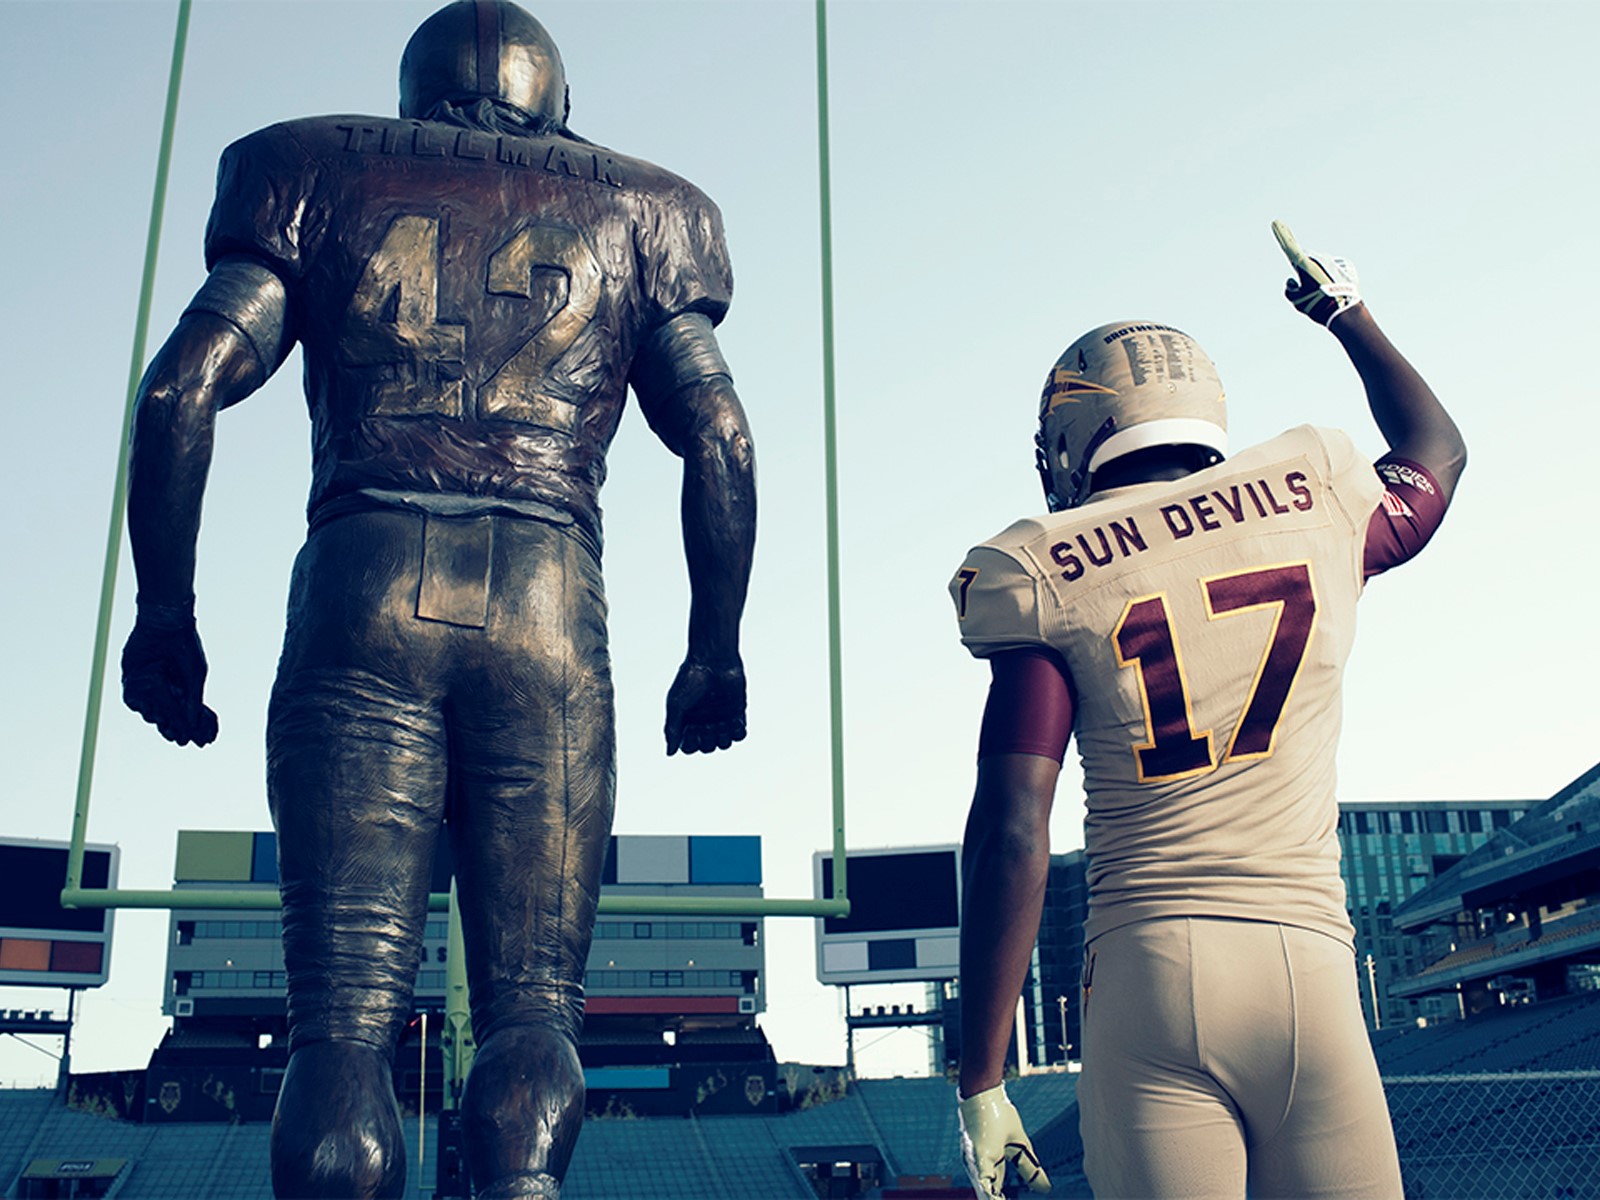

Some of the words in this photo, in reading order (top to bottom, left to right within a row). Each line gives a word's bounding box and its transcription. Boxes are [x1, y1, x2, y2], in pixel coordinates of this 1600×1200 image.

[344, 213, 601, 432] 42
[1050, 516, 1148, 582] SUN
[1159, 471, 1314, 540] DEVILS
[1111, 558, 1320, 784] 17
